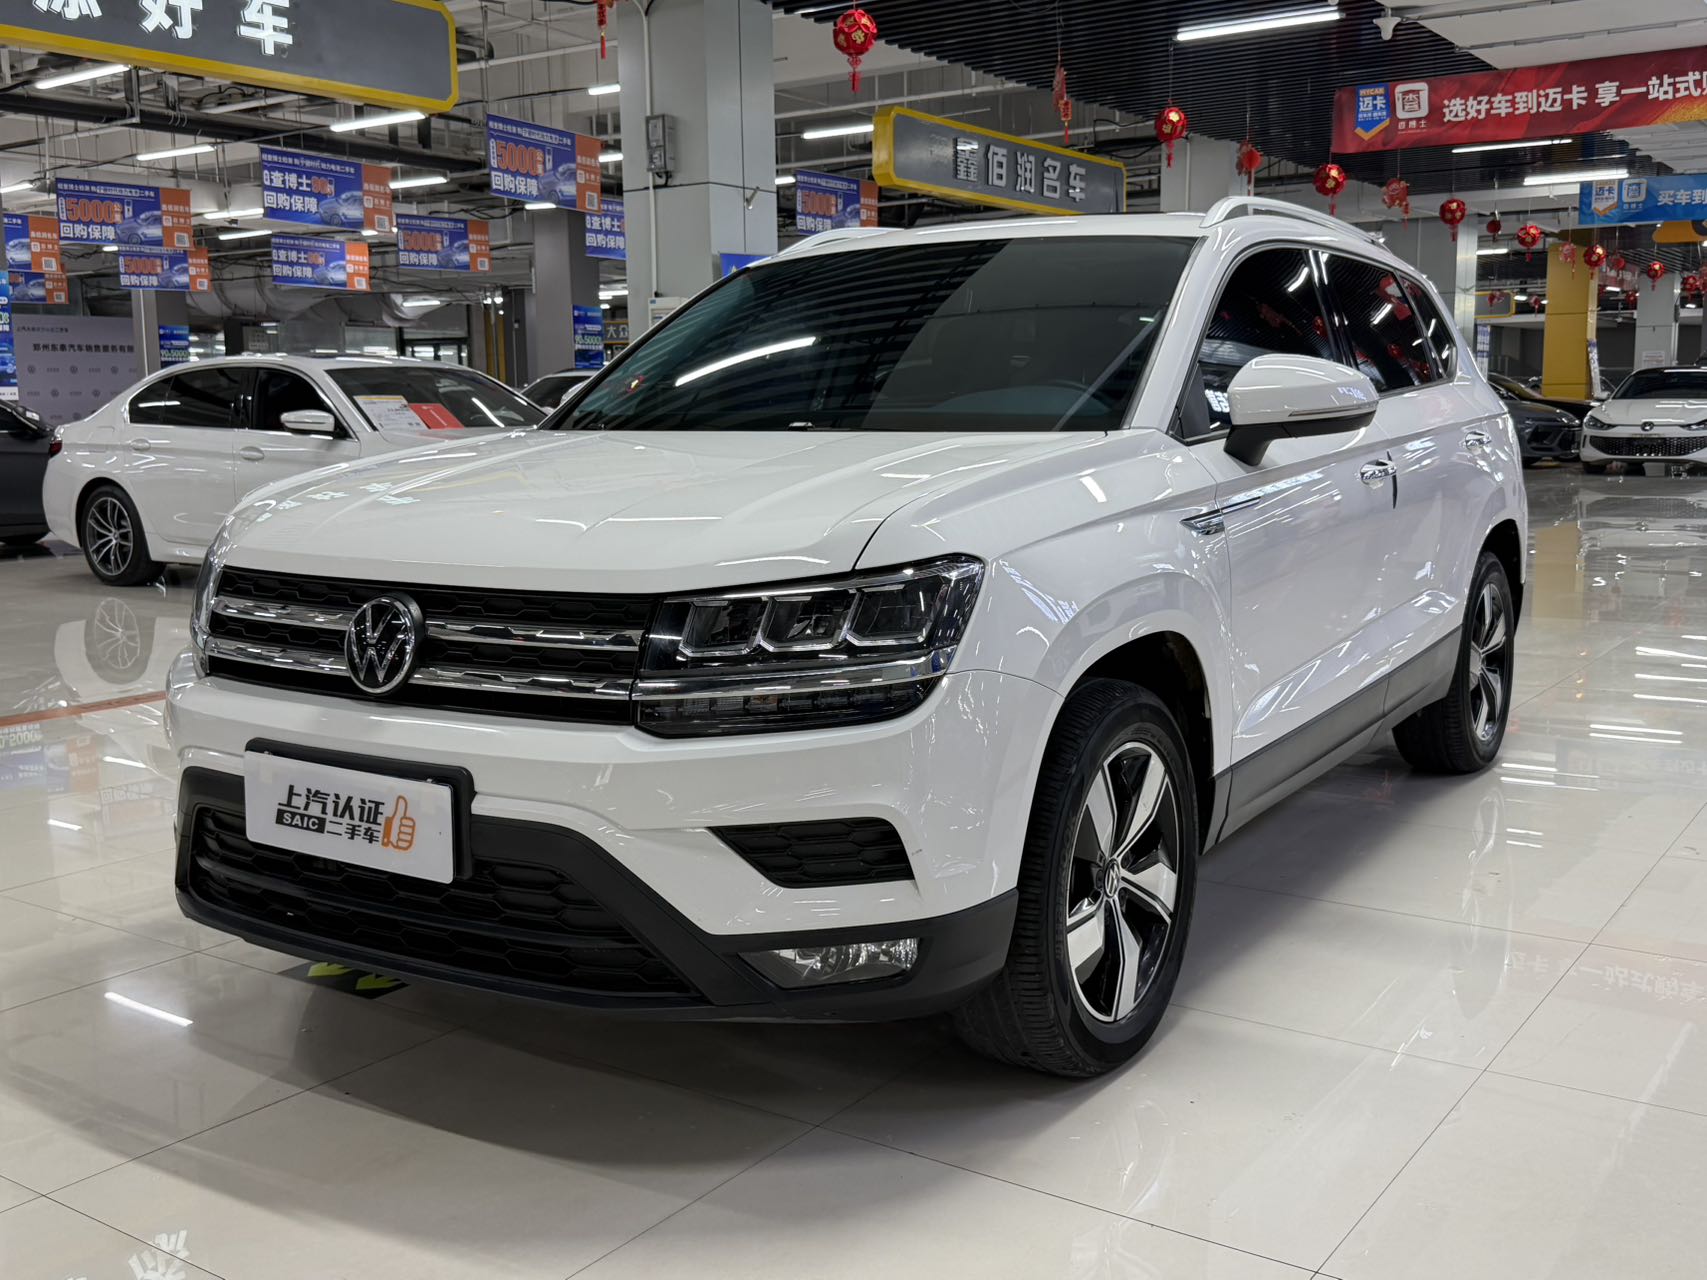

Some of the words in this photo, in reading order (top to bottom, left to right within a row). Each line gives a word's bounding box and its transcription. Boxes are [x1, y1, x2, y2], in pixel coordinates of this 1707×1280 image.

[1359, 96, 1386, 112] 迈卡
[1443, 85, 1588, 122] 选好车到迈卡
[496, 140, 537, 175] 5000
[271, 170, 311, 192] 查博士
[955, 138, 1086, 202] 鑫佰润名车
[491, 171, 539, 197] 回购保障
[66, 197, 113, 224] 5000
[264, 191, 318, 213] 回购保障
[60, 222, 115, 240] 回购保障
[273, 264, 313, 278] 回购保障
[278, 784, 385, 826] 上汽认证
[282, 812, 319, 830] SAIC
[326, 820, 381, 844] 二手车
